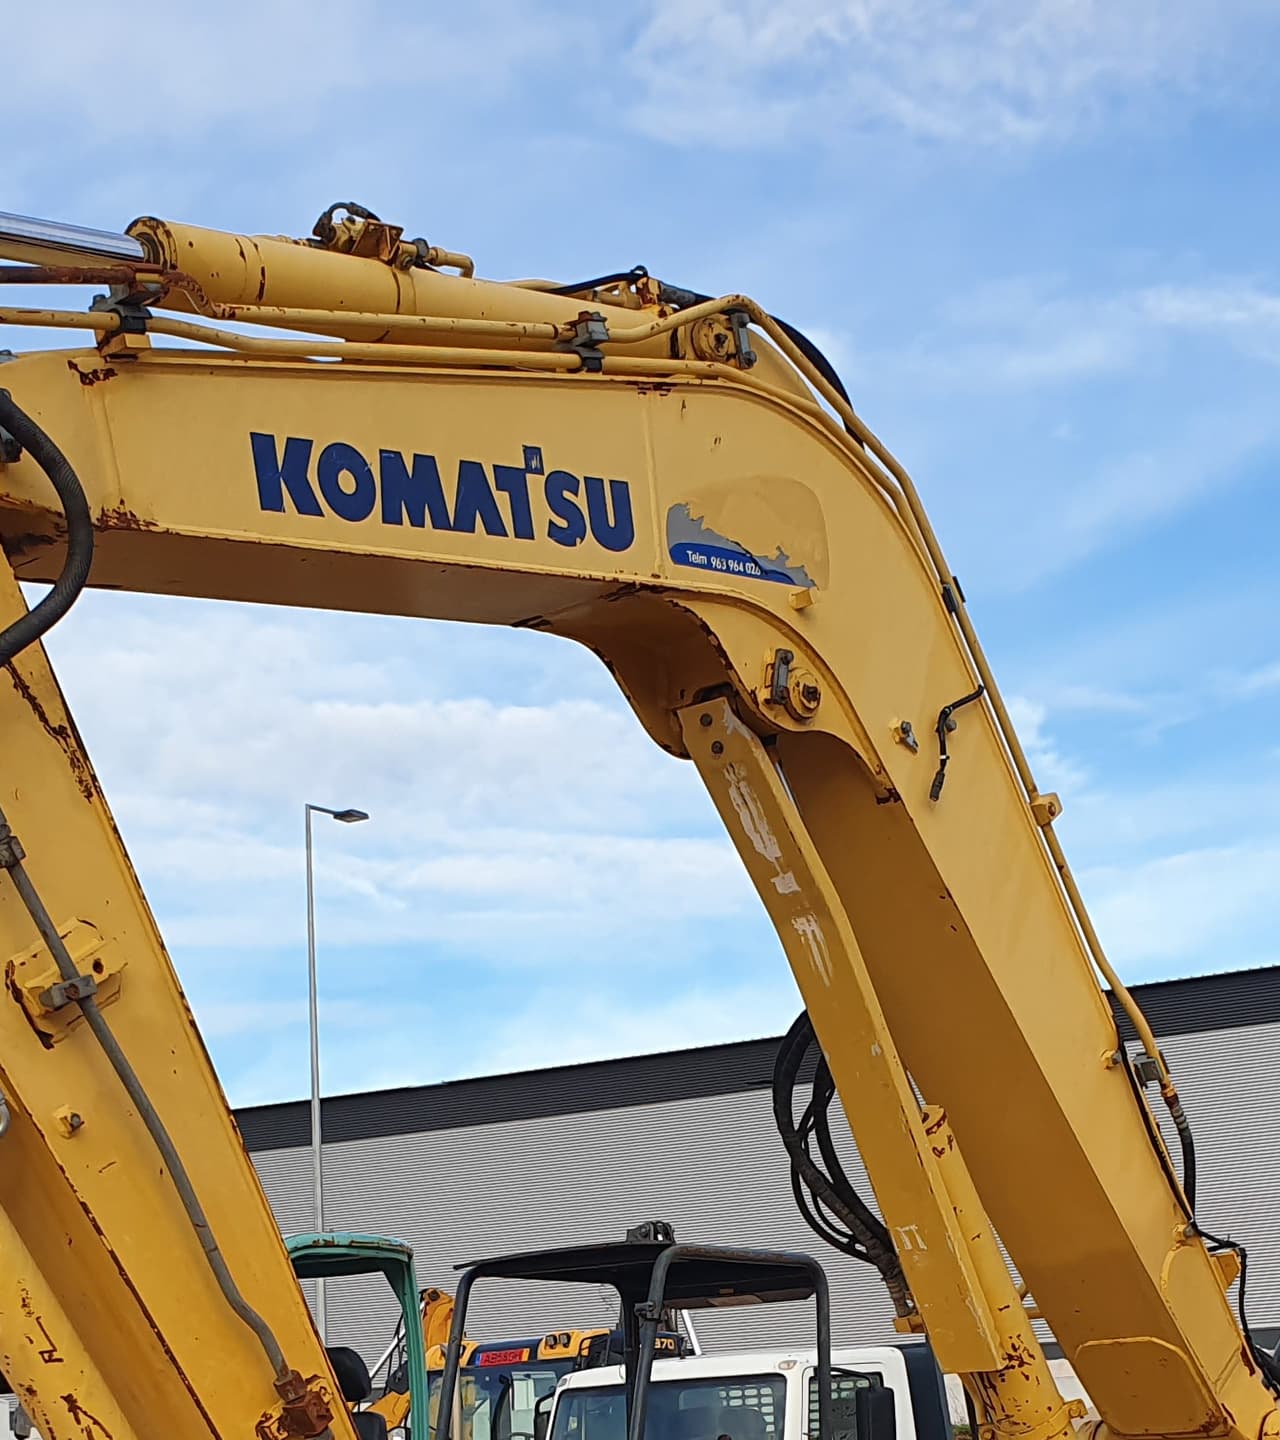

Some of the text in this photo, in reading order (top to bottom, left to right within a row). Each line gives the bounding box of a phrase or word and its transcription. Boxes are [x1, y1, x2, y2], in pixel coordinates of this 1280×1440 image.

[249, 430, 636, 552] KOMATSU
[710, 556, 727, 570] 963
[728, 559, 744, 573] 964
